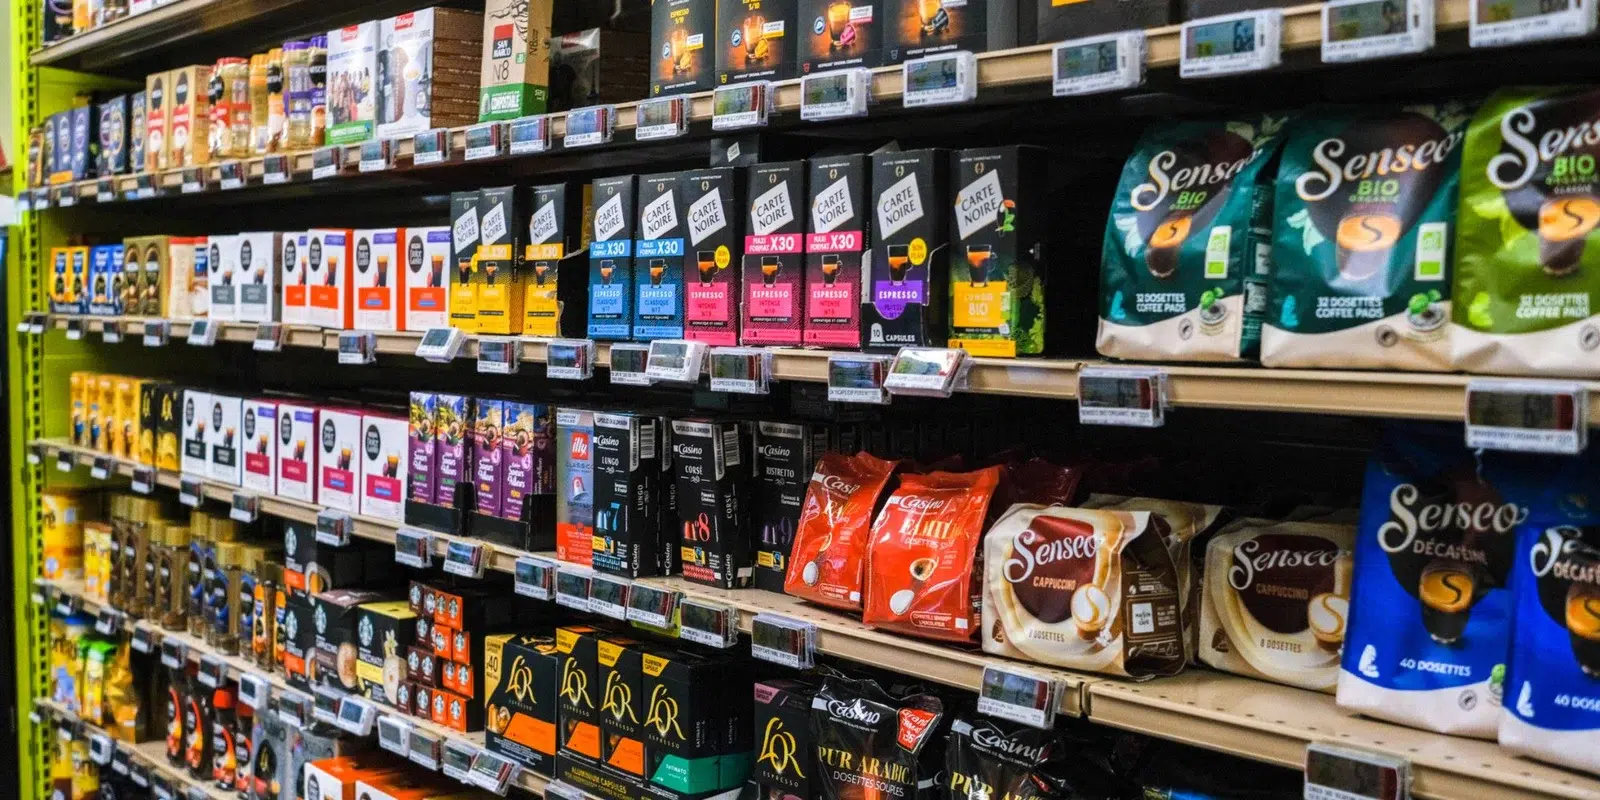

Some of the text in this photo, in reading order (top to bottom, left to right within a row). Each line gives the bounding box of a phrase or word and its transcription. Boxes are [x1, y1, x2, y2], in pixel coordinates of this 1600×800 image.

[498, 40, 508, 49] SAN
[1295, 132, 1462, 201] Senseo
[1553, 156, 1596, 177] BIO
[1179, 190, 1207, 204] BIO
[1357, 179, 1399, 196] BIO
[757, 192, 784, 218] CARTE
[817, 188, 845, 214] CARTE
[883, 186, 914, 212] CARTE
[961, 184, 995, 212] CARTE
[483, 210, 501, 230] CARTE
[533, 209, 552, 230] CARTE
[598, 204, 618, 226] CARTE
[646, 200, 671, 224] CARTE
[692, 199, 718, 223] CARTE
[759, 205, 787, 231] NOIRE
[820, 201, 847, 228] NOIRE
[886, 200, 916, 227] NOIRE
[965, 198, 998, 228] NOIRE
[456, 216, 475, 234] CARTE
[485, 221, 504, 242] NOIRE
[534, 220, 554, 240] NOIRE
[599, 214, 620, 237] NOIRE
[648, 210, 672, 236] NOIRE
[694, 211, 721, 235] NOIRE
[457, 227, 476, 246] NOIRE
[770, 236, 794, 251] X30
[830, 234, 854, 249] X30
[608, 242, 624, 254] X30
[657, 241, 678, 254] X30
[752, 290, 789, 298] ESPRESSO
[813, 290, 848, 298] ESPRESSO
[879, 290, 918, 299] ESPRESSO
[1144, 293, 1186, 303] DOSETTES
[1330, 297, 1383, 308] DOSETTES
[1535, 292, 1589, 306] DOSETTES
[1136, 303, 1186, 312] COFFEE PADS
[1316, 308, 1384, 318] COFFEE PADS
[1516, 306, 1560, 318] COFFEE
[873, 329, 915, 342] 10 CAPSULES
[572, 437, 588, 457] illy
[598, 435, 620, 446] Casino
[678, 444, 702, 455] Casino
[764, 444, 790, 457] Casino
[602, 456, 619, 466] LUNGO
[685, 465, 703, 475] CORSÉ
[766, 466, 794, 478] RISTRETTO
[824, 475, 860, 495] Casi
[724, 494, 732, 519] CORSÉ
[900, 495, 944, 510] Casino
[1003, 529, 1104, 583] Senseo
[1228, 540, 1351, 590] Senseo
[1033, 576, 1077, 591] CAPPUCCINO
[1256, 583, 1309, 600] CAPPUCCINO
[1266, 640, 1302, 654] DOSETTES
[487, 656, 499, 672] 40
[1400, 657, 1471, 677] 40 DOSETTES
[505, 655, 537, 704] L'OR
[560, 656, 595, 709] L'OR
[601, 670, 640, 724] L'OR
[1554, 694, 1569, 706] 40
[563, 704, 590, 717] ESPRESSO
[644, 683, 686, 740] L'OR
[827, 698, 880, 724] Casino
[605, 718, 635, 732] ESPRESSO
[648, 734, 680, 750] ESPRESSO
[757, 716, 807, 779] L'OR
[818, 746, 851, 770] PUR
[762, 770, 799, 788] ESPRESSO
[834, 770, 904, 798] DOSETTES SOUPLES
